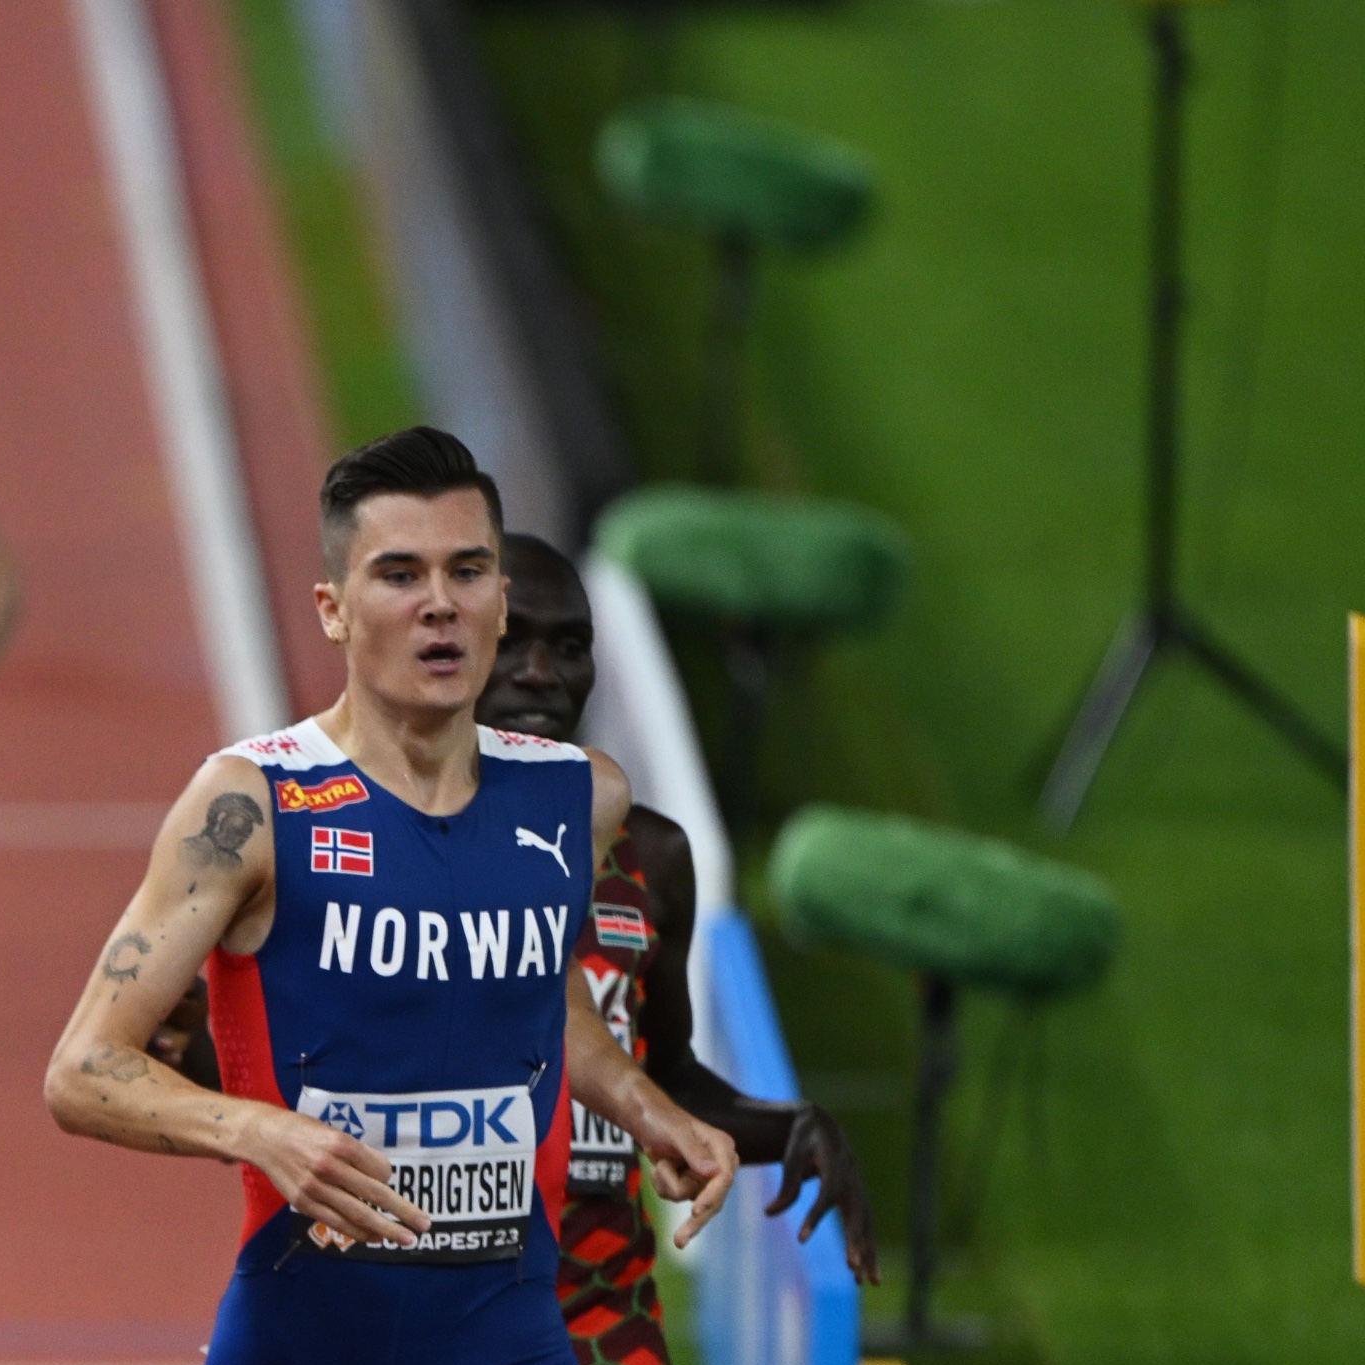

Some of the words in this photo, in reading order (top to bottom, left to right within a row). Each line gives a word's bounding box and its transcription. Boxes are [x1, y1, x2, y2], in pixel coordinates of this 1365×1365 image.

[305, 782, 360, 806] EXTRA
[319, 902, 568, 981] NORWAY
[365, 1096, 519, 1148] TDK
